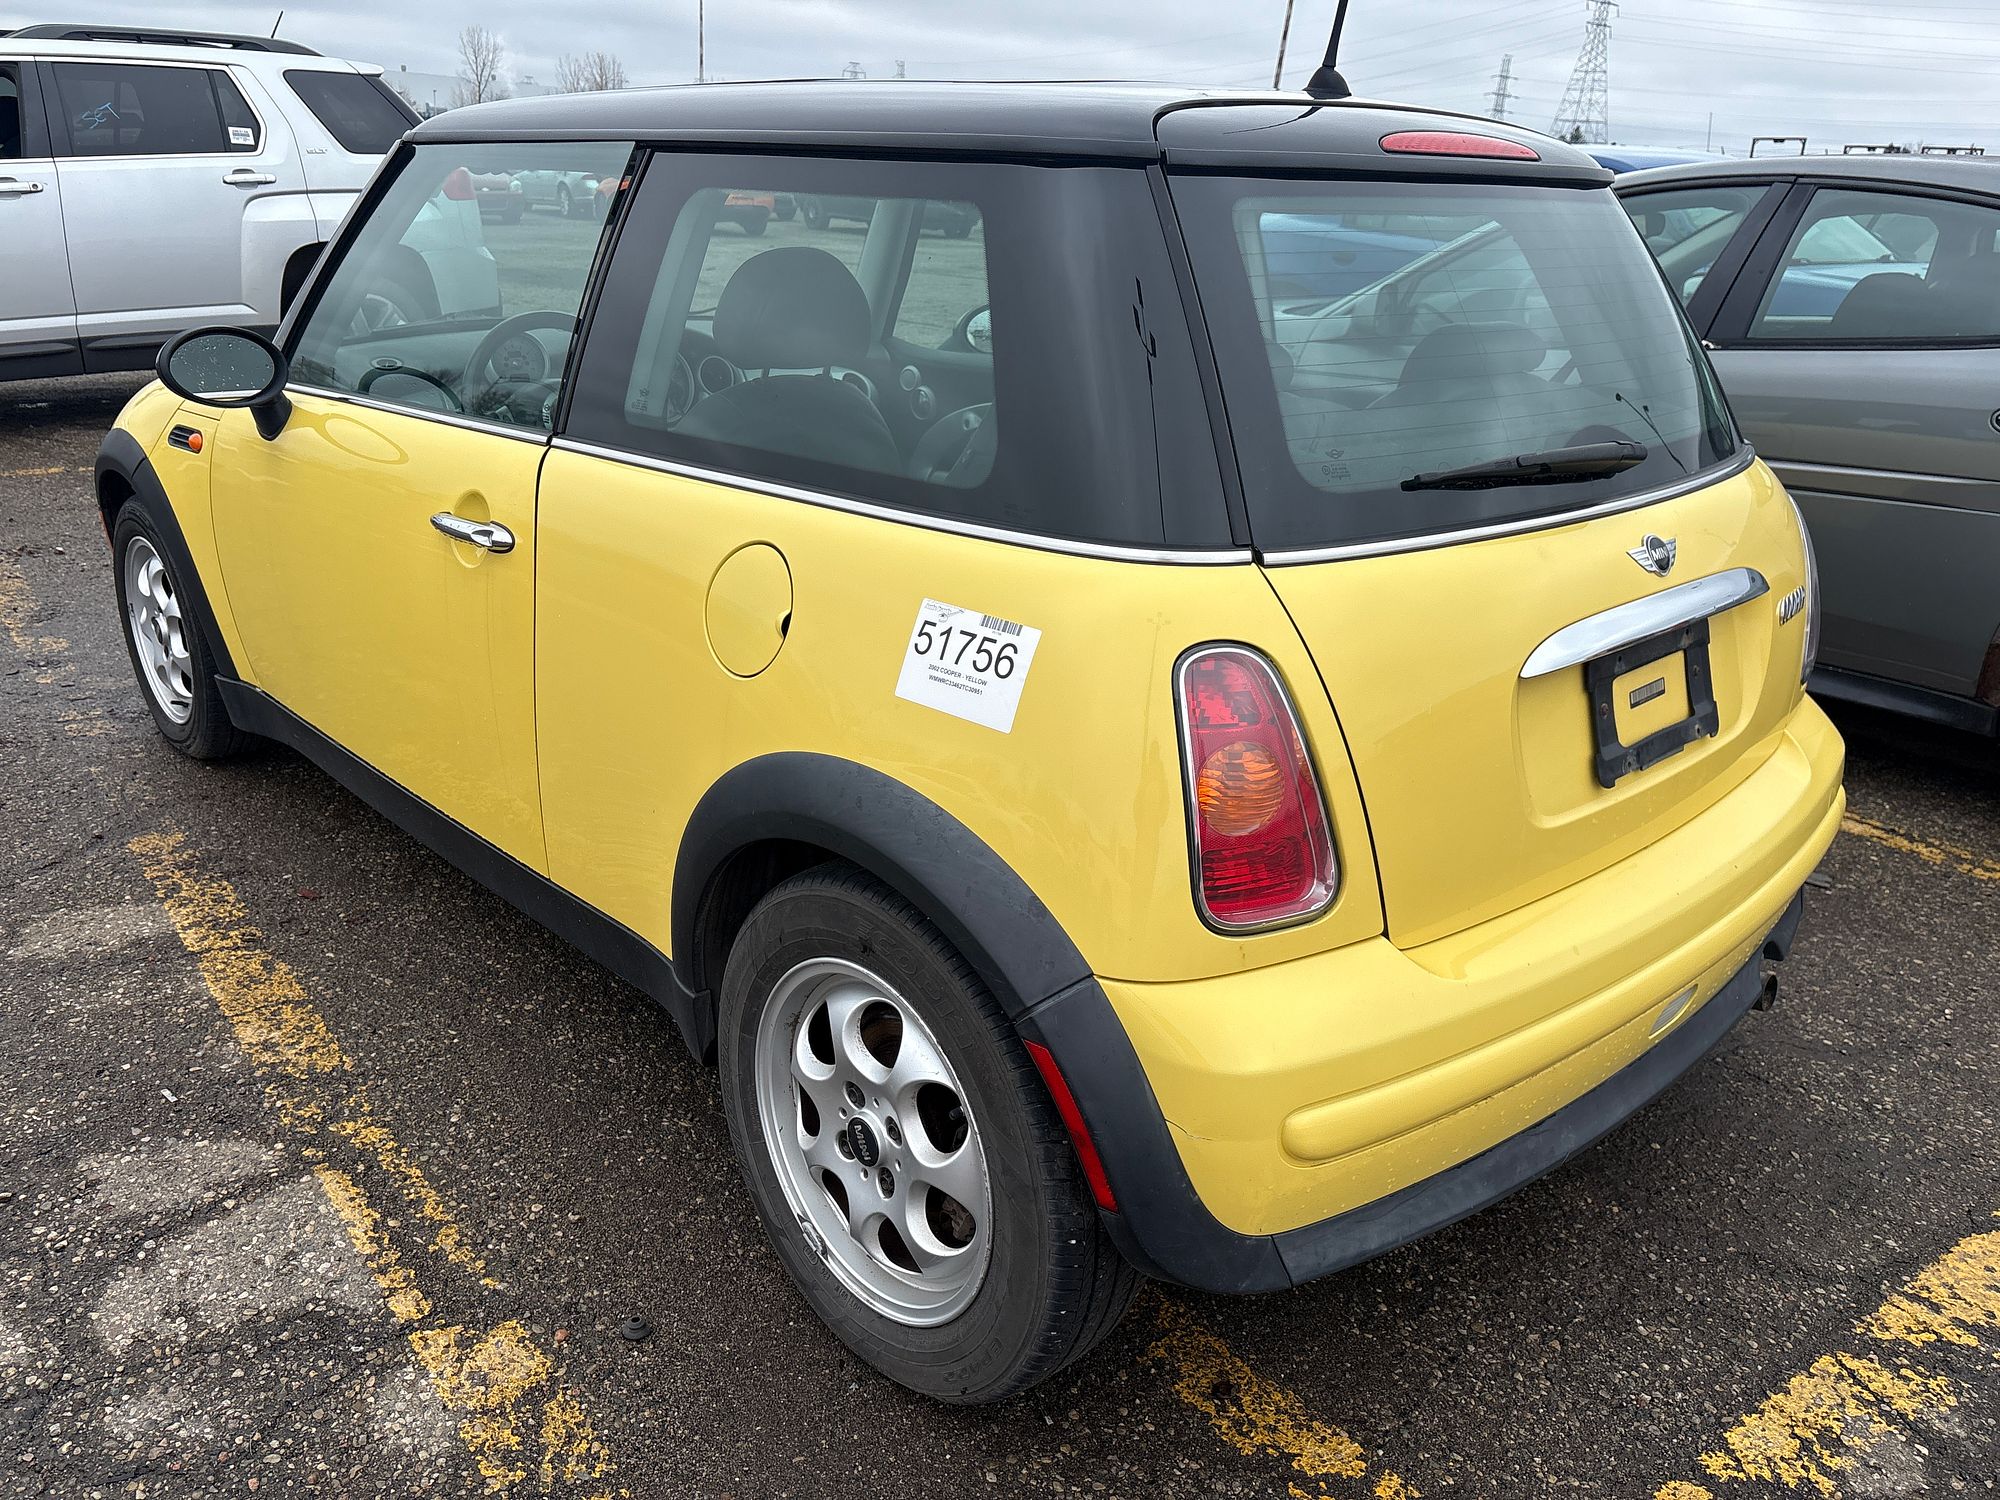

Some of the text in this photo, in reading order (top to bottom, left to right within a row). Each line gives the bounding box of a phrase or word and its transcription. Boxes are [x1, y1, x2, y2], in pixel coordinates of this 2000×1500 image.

[914, 619, 1019, 679] 51756
[940, 667, 962, 679] COOPER
[965, 674, 988, 687] YELLOW
[854, 1124, 872, 1160] MINI
